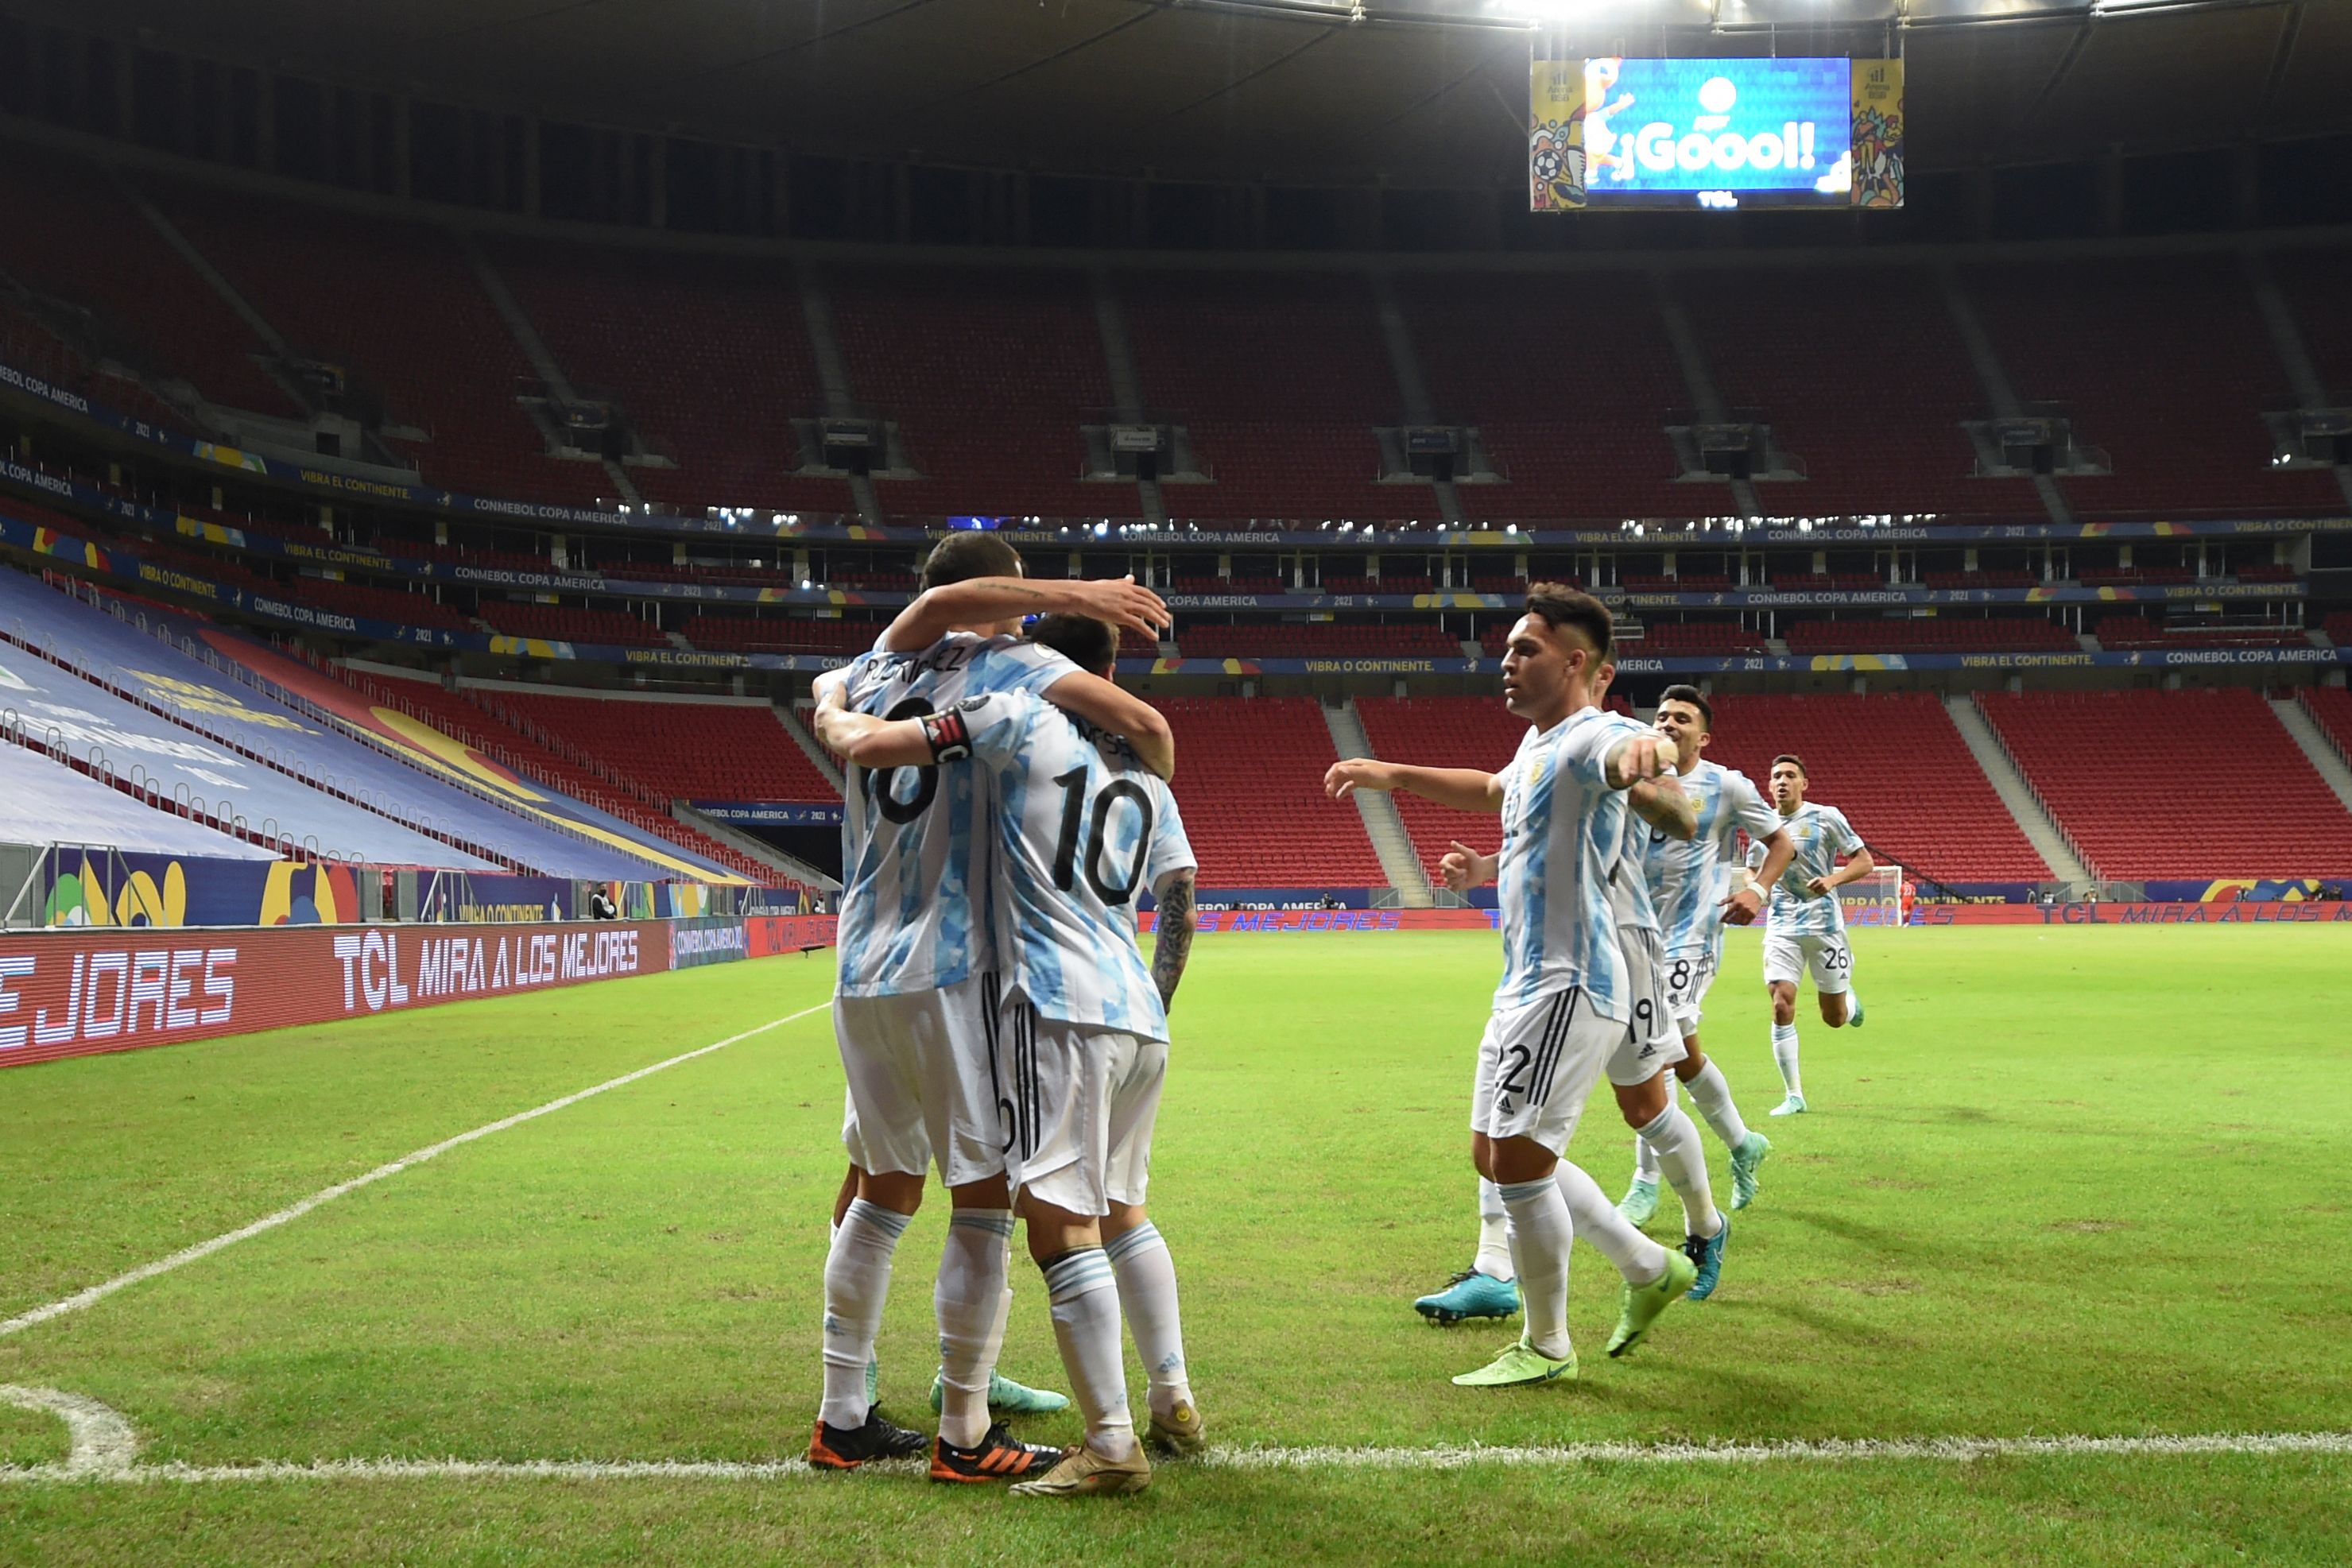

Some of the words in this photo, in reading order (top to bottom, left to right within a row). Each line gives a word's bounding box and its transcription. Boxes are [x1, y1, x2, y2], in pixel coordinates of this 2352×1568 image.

[25, 377, 48, 398] COPA
[51, 387, 88, 413] AMERICA
[136, 422, 150, 438] 2021
[9, 464, 32, 486] COPA
[34, 473, 72, 498] AMERICA
[300, 469, 330, 486] VIBRA
[333, 476, 343, 488] EL
[474, 498, 537, 517] CONMEBOL
[539, 506, 571, 521] COPA
[573, 510, 628, 525] AMERICA
[703, 521, 722, 532] 2021
[2005, 526, 2025, 536] 2021
[2234, 521, 2271, 532] VIBRA
[2275, 521, 2285, 531] O
[1122, 531, 1187, 543] CONMEBOL
[1189, 532, 1222, 543] COPA
[1225, 532, 1280, 543] AMERICA
[1355, 532, 1374, 543] 2021
[1576, 532, 1609, 542] VIBRA
[1611, 532, 1623, 542] EL
[1768, 528, 1832, 540] CONMEBOL
[1835, 528, 1868, 540] COPA
[1872, 528, 1928, 539] AMERICA
[283, 542, 313, 559] VIBRA
[316, 548, 326, 559] EL
[138, 562, 162, 584] VIBRA
[162, 570, 169, 585] O
[455, 566, 515, 583] CONMEBOL
[518, 573, 550, 587] COPA
[553, 576, 606, 591] AMERICA
[683, 586, 702, 597] 2021
[1748, 593, 1812, 604] CONMEBOL
[1815, 592, 1848, 603] COPA
[1850, 591, 1907, 602] AMERICA
[1950, 590, 1969, 601] 2021
[2165, 587, 2202, 598] VIBRA
[2205, 586, 2215, 596] O
[1167, 595, 1199, 606] COPA
[1202, 595, 1257, 606] AMERICA
[1334, 595, 1353, 606] 2021
[254, 596, 293, 619] CONMEBOL
[294, 606, 314, 623] COPA
[316, 612, 356, 632] AMERICA
[415, 627, 432, 642] 2021
[625, 649, 658, 663] VIBRA
[661, 651, 673, 664] EL
[1744, 658, 1763, 669] 2021
[1961, 656, 1997, 668] VIBRA
[1999, 656, 2012, 667] EL
[2166, 651, 2236, 664] CONMEBOL
[2239, 650, 2273, 663] COPA
[2277, 649, 2337, 662] AMERICA
[1305, 660, 1340, 672] VIBRA
[1343, 660, 1353, 672] O
[1615, 660, 1664, 671] MERICA
[730, 809, 750, 819] COPA
[751, 810, 789, 819] AMERICA
[811, 811, 826, 820] 2021
[1052, 764, 1153, 906] 10
[2036, 903, 2106, 924] TCL
[2120, 904, 2207, 923] MIRA
[2218, 904, 2240, 923] A
[2253, 904, 2328, 923] LOS
[1230, 912, 1404, 932] MEJORES
[1823, 947, 1848, 970] 26
[334, 929, 409, 1011] TCL
[417, 938, 486, 997] MIRA
[491, 937, 509, 988] A
[515, 935, 556, 985] LOS
[560, 930, 638, 979] MEJORES
[1670, 959, 1690, 990] 8
[0, 948, 238, 1049] EJORES
